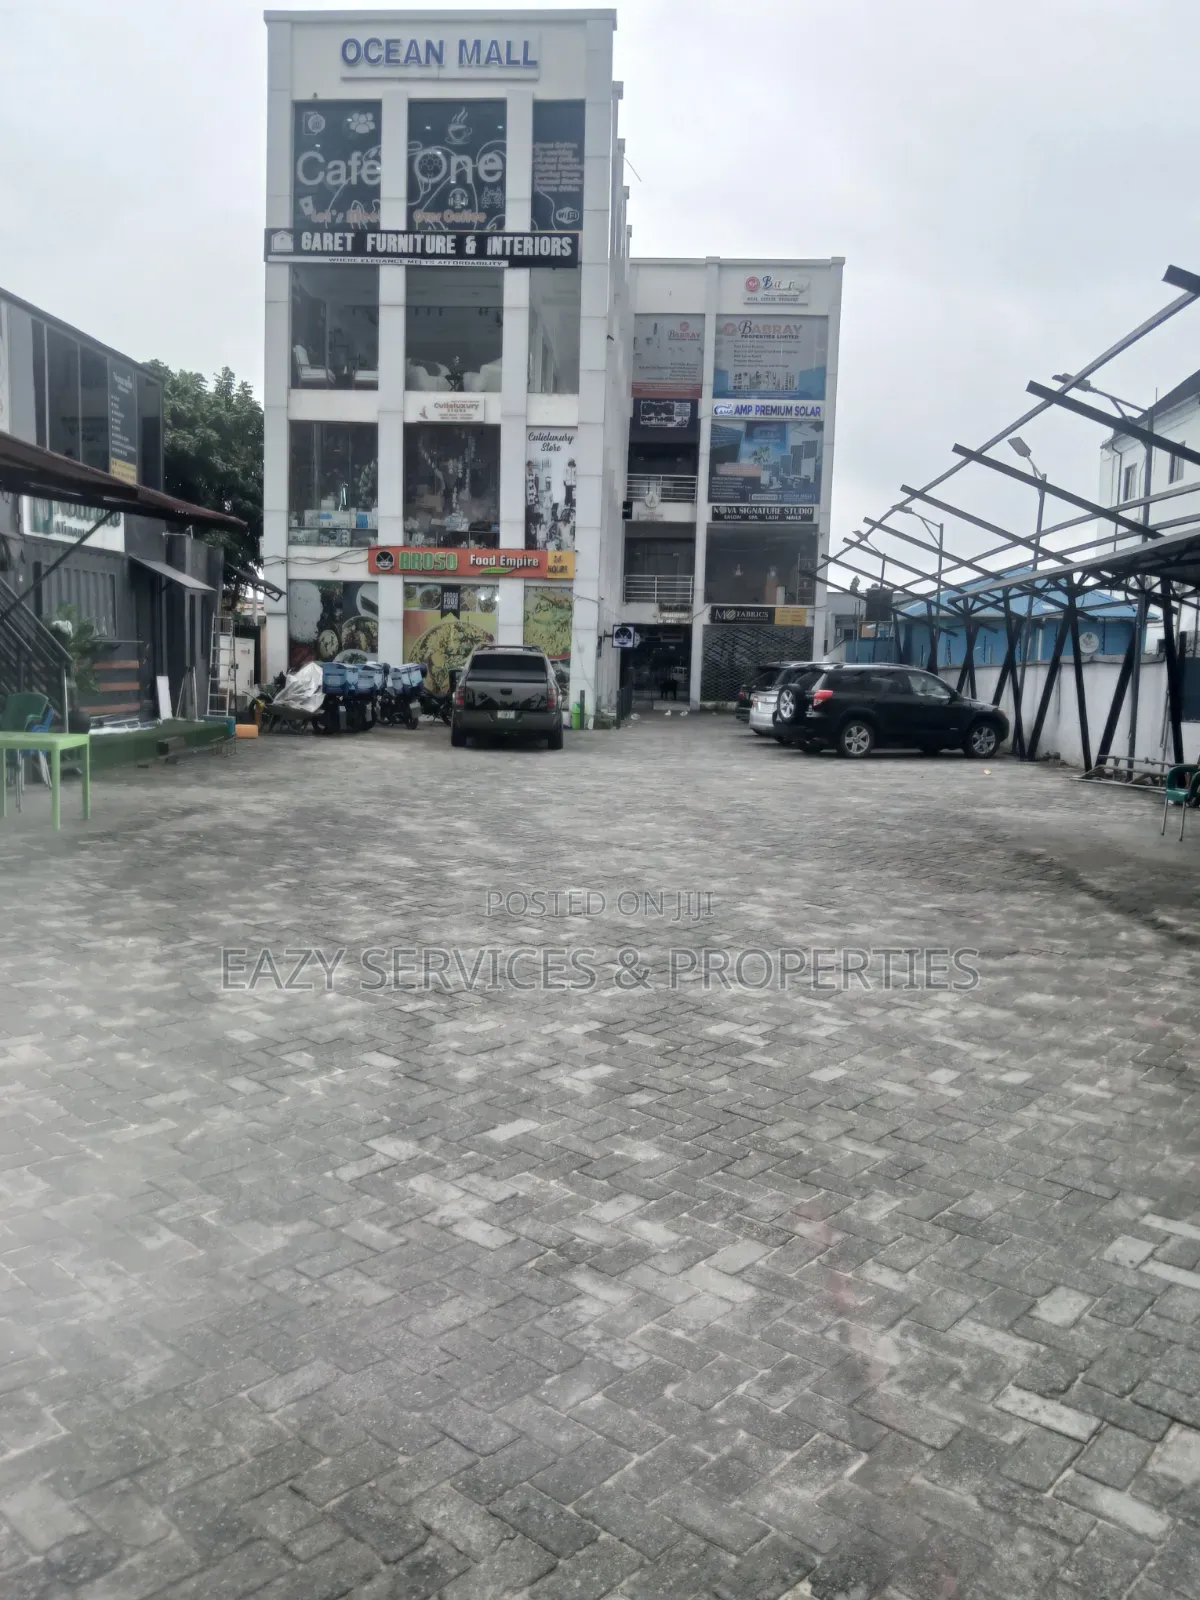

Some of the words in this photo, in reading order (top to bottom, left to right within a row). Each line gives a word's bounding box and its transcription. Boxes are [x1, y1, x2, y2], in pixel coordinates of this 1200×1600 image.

[341, 38, 445, 66] OCEAN
[458, 39, 538, 66] MALL
[414, 148, 504, 184] One
[301, 231, 355, 251] GARET
[366, 233, 456, 254] FURNITURE
[465, 235, 477, 255] &
[733, 404, 753, 415] AMP
[754, 405, 793, 416] PREMIUM
[794, 406, 822, 417] SOLAR
[540, 442, 562, 452] Store
[739, 507, 782, 515] SIGNATURE
[784, 507, 813, 515] STUDIO
[399, 551, 458, 571] AROSO
[470, 554, 496, 567] Food
[500, 555, 539, 569] Empire
[547, 565, 568, 574] HOURS
